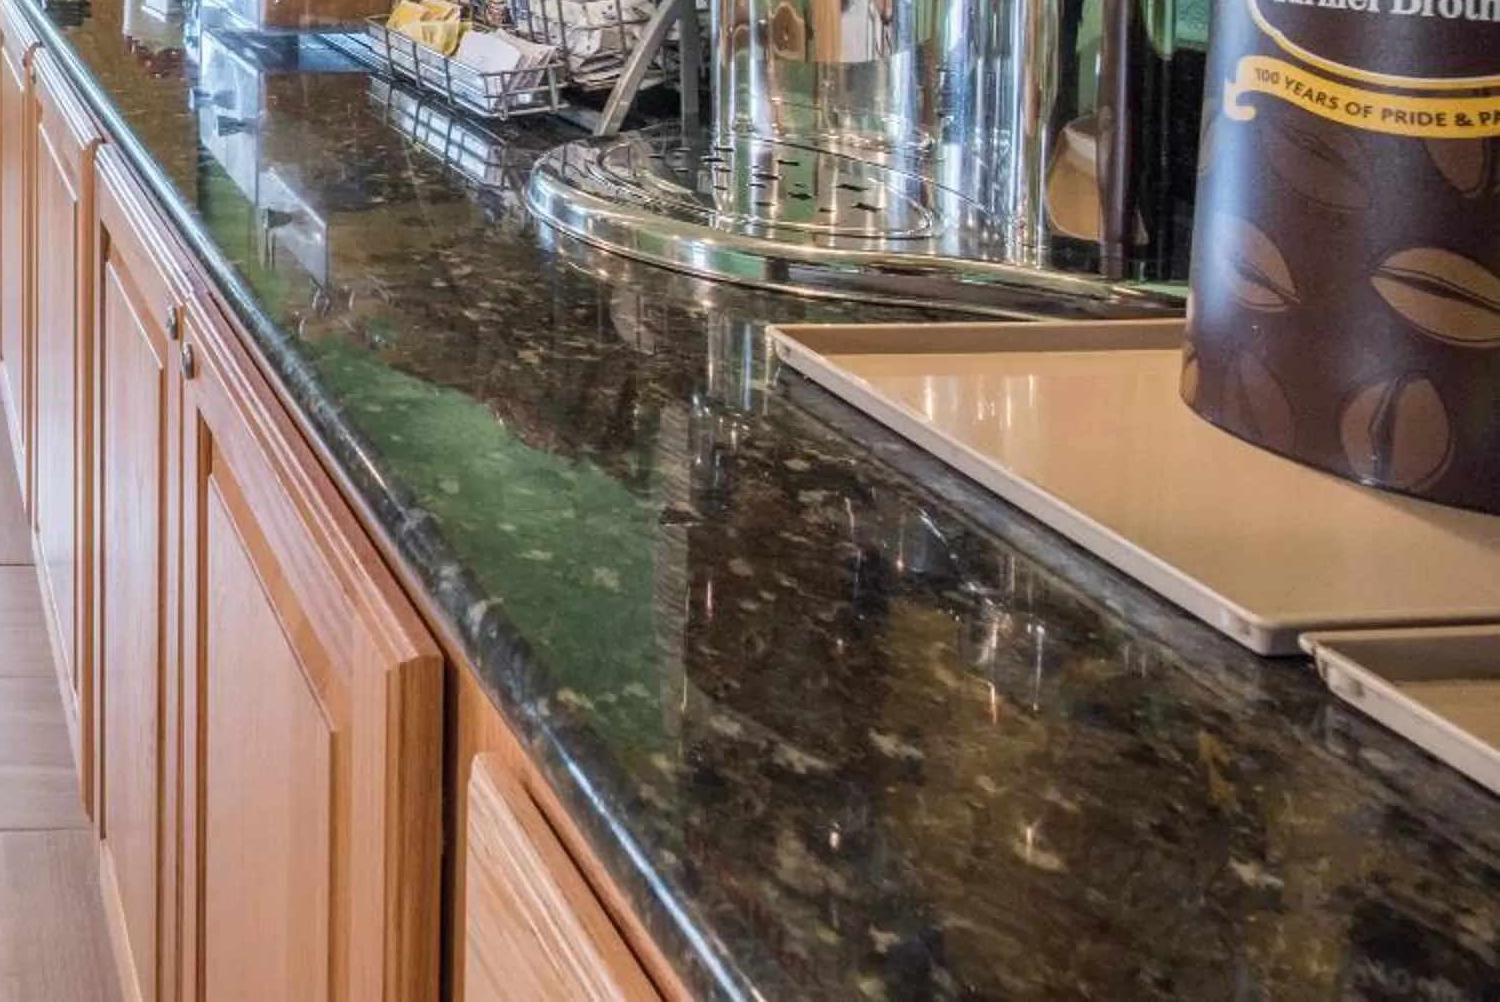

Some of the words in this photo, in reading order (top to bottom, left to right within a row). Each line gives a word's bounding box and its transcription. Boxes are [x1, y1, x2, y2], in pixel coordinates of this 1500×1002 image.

[1254, 68, 1280, 85] 100
[1284, 76, 1339, 110] YEARS
[1345, 101, 1373, 118] OF
[1380, 107, 1448, 127] PRIDE
[1454, 112, 1475, 127] &
